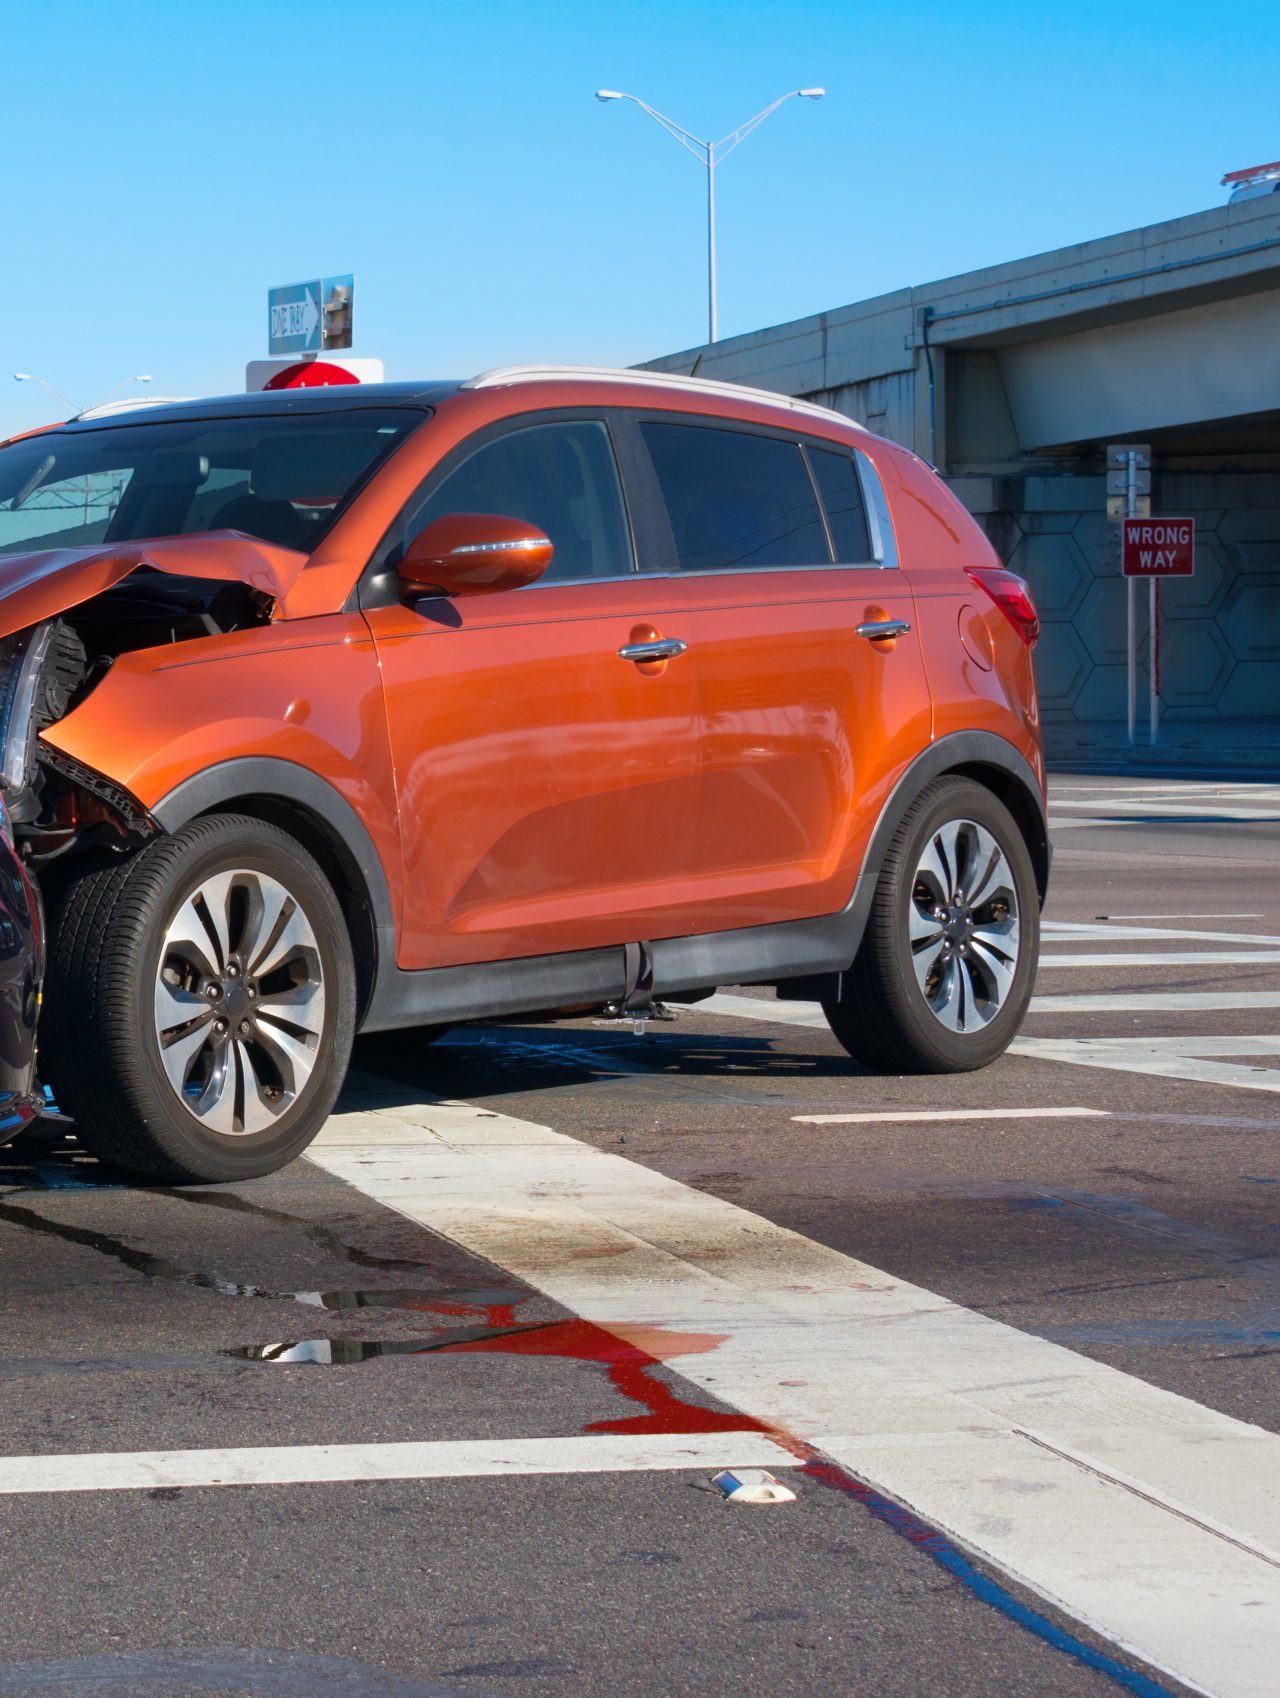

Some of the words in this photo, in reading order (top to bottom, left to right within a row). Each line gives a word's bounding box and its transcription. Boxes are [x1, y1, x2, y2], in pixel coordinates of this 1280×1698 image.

[290, 305, 305, 333] WAY
[1127, 526, 1189, 544] WRONG
[1139, 550, 1176, 568] WAY
